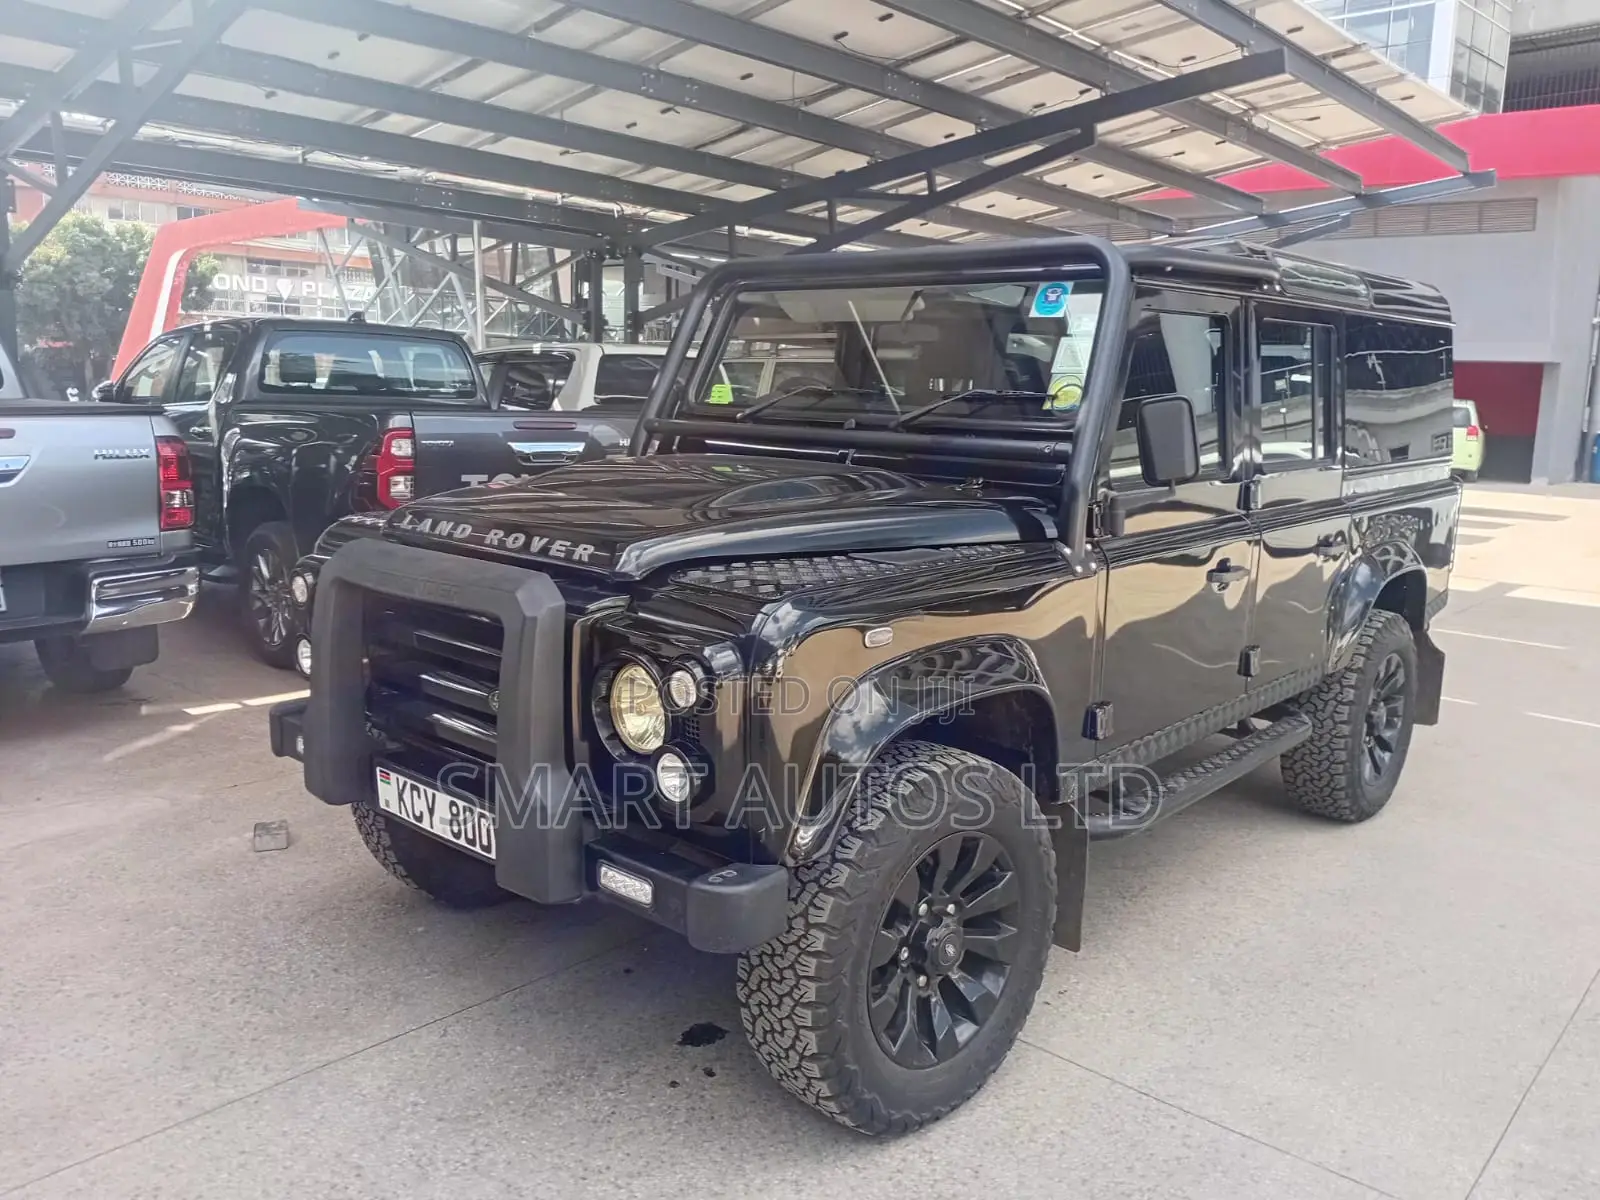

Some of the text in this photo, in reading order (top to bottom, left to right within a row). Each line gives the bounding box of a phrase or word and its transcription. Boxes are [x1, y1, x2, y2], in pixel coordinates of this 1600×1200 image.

[208, 273, 268, 293] OND
[401, 514, 595, 562] LAND ROVER
[396, 776, 436, 830] KCY
